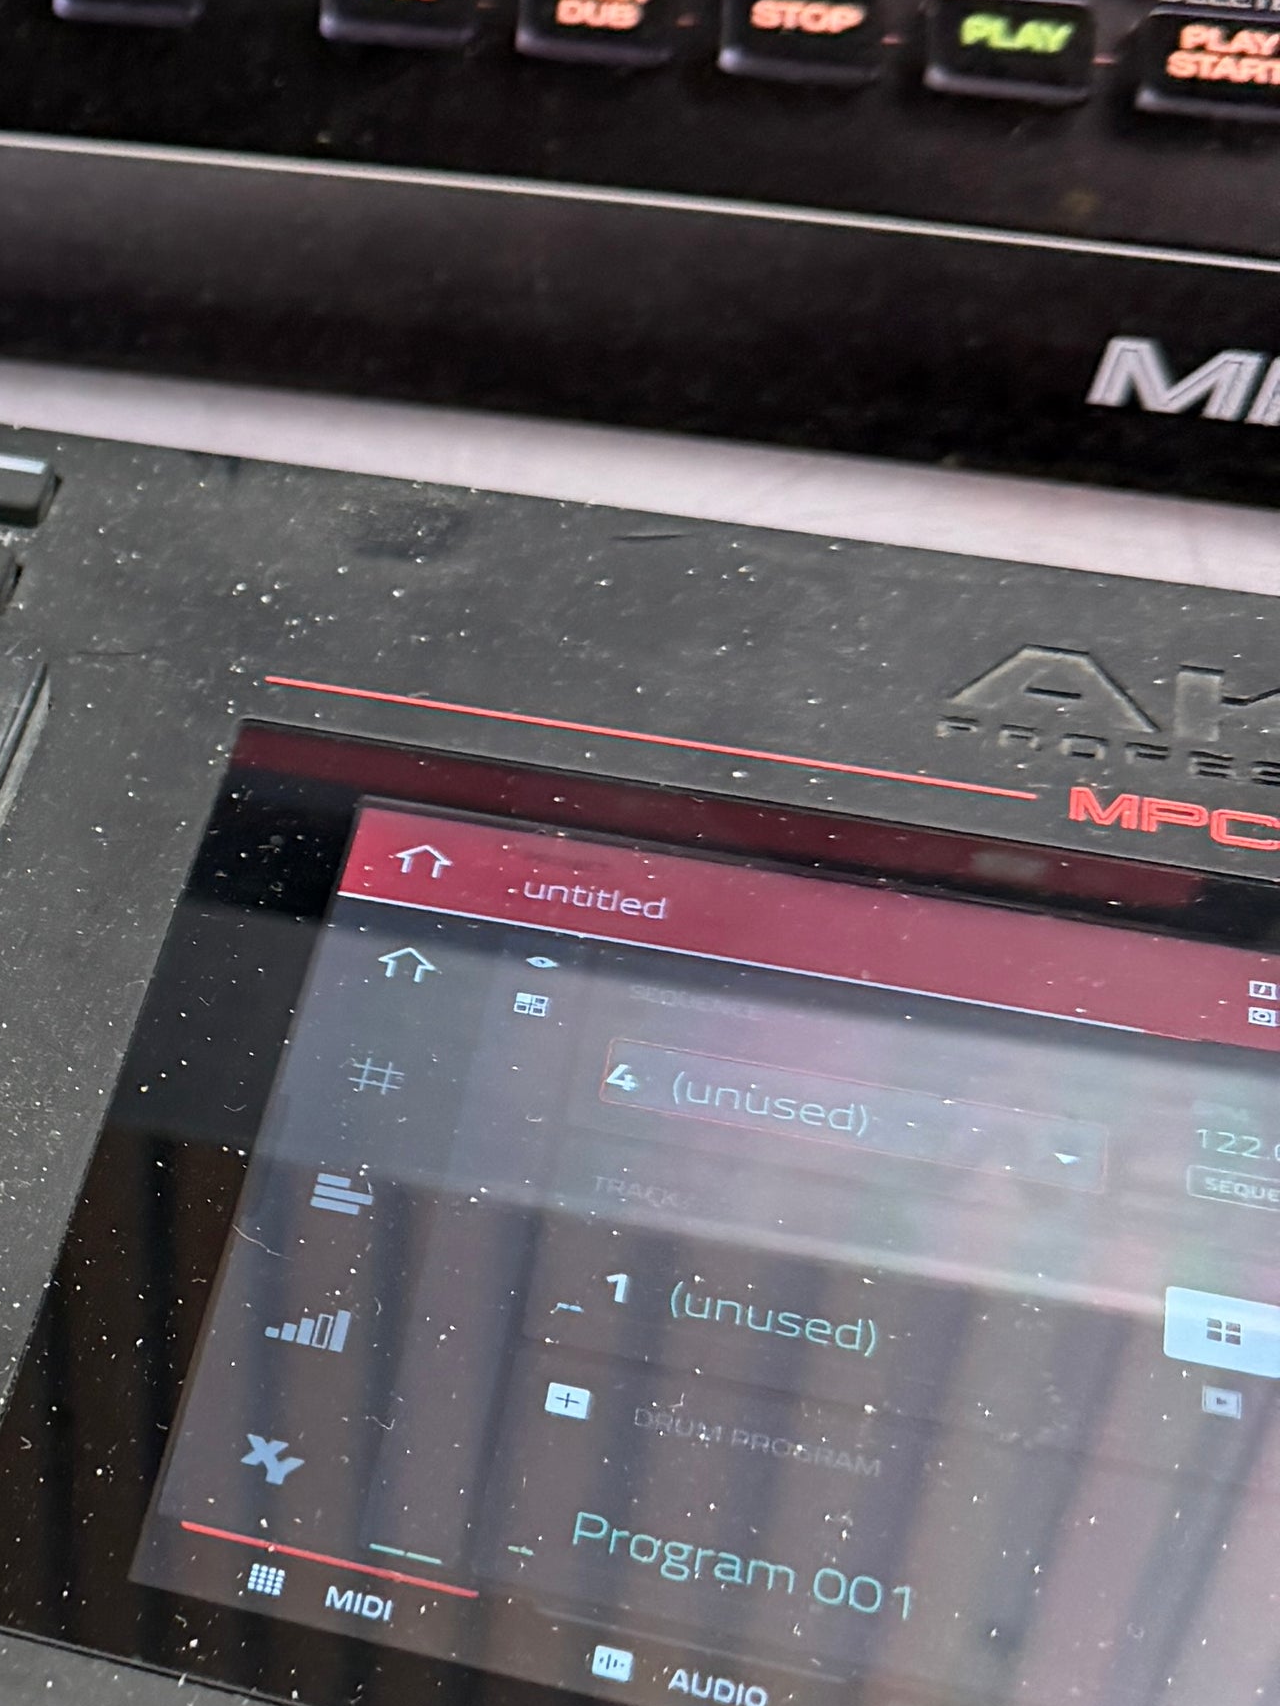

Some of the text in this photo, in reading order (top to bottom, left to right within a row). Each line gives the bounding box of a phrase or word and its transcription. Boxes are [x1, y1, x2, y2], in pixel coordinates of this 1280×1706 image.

[554, 0, 643, 32] DUB
[959, 12, 1076, 55] PLAY
[1179, 24, 1280, 56] PLAY
[1068, 785, 1280, 853] MPC
[523, 880, 669, 921] untitled
[606, 1063, 868, 1138] 4 (unused)
[1195, 1128, 1280, 1162] 122.
[606, 1272, 878, 1357] 1 (unused)
[571, 1510, 914, 1622] Program 001
[324, 1584, 394, 1622] MIDI
